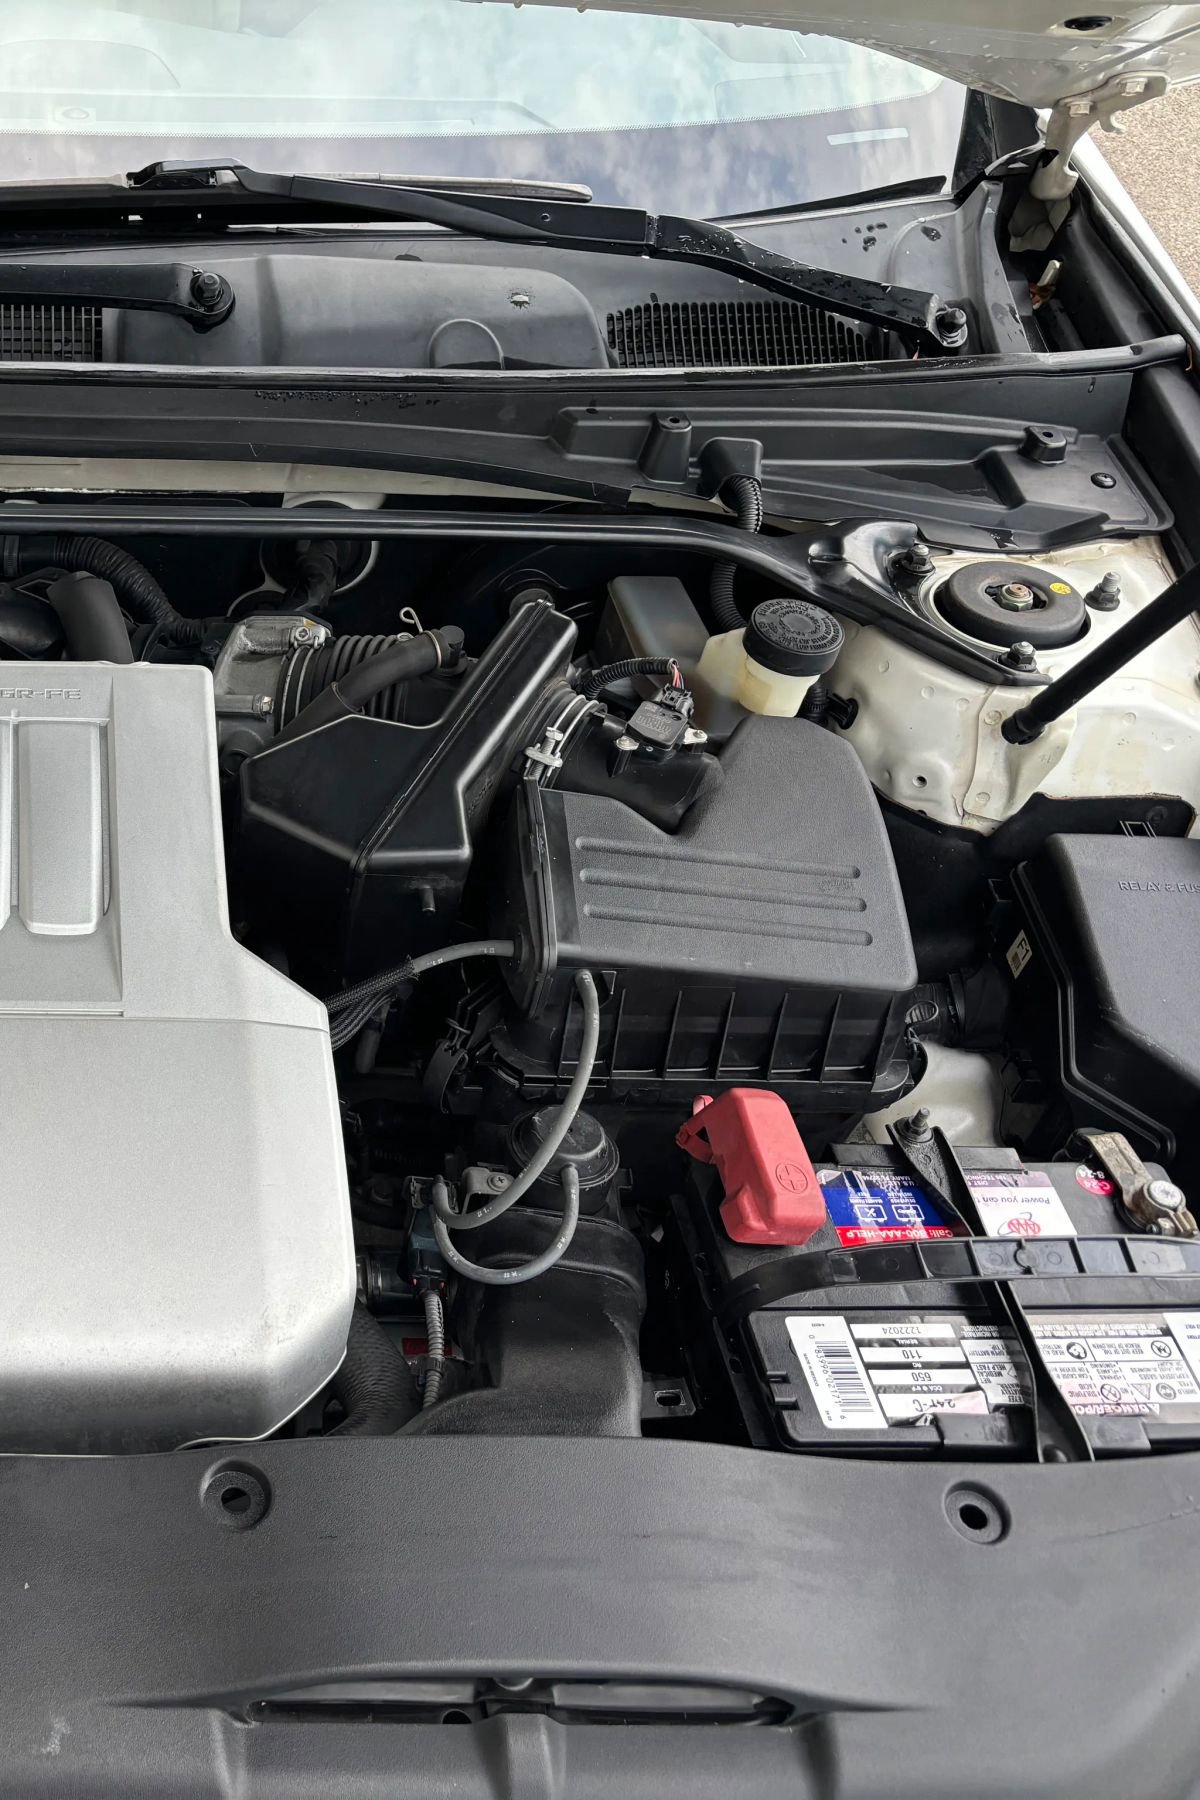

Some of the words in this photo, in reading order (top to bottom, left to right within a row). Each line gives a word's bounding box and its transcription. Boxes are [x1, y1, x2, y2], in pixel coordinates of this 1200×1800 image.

[1118, 880, 1161, 892] RELAY
[1078, 1169, 1106, 1179] 8-24
[1083, 1180, 1111, 1191] C-24
[982, 1196, 999, 1204] can
[1001, 1192, 1018, 1204] you
[1020, 1196, 1050, 1205] Power
[1009, 1218, 1040, 1236] AAA
[929, 1229, 953, 1239] Call:
[902, 1349, 923, 1360] 110
[911, 1371, 932, 1382] 650
